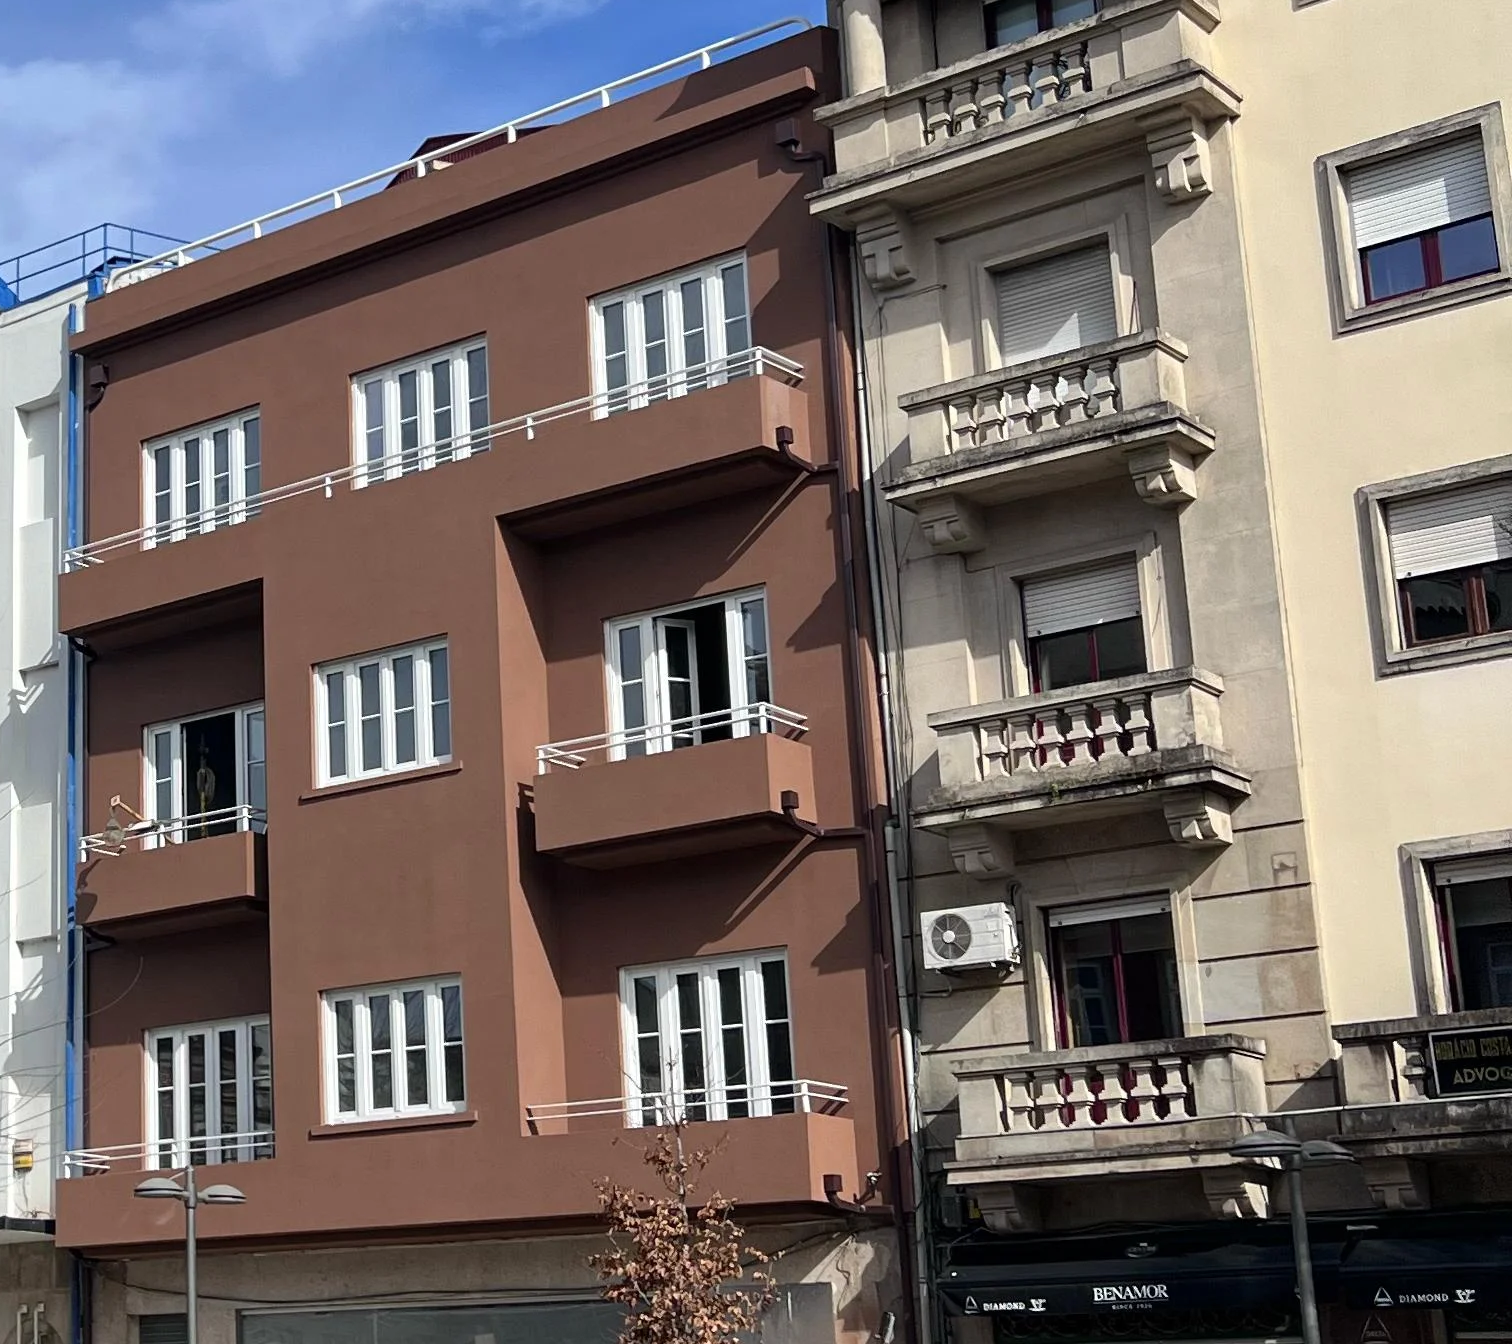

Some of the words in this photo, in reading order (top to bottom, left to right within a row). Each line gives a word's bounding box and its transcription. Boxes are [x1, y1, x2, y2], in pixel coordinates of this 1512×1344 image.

[1093, 1284, 1169, 1302] BENAMOR
[1399, 1293, 1449, 1304] DIAMOND
[983, 1302, 1026, 1312] DIAMOND
